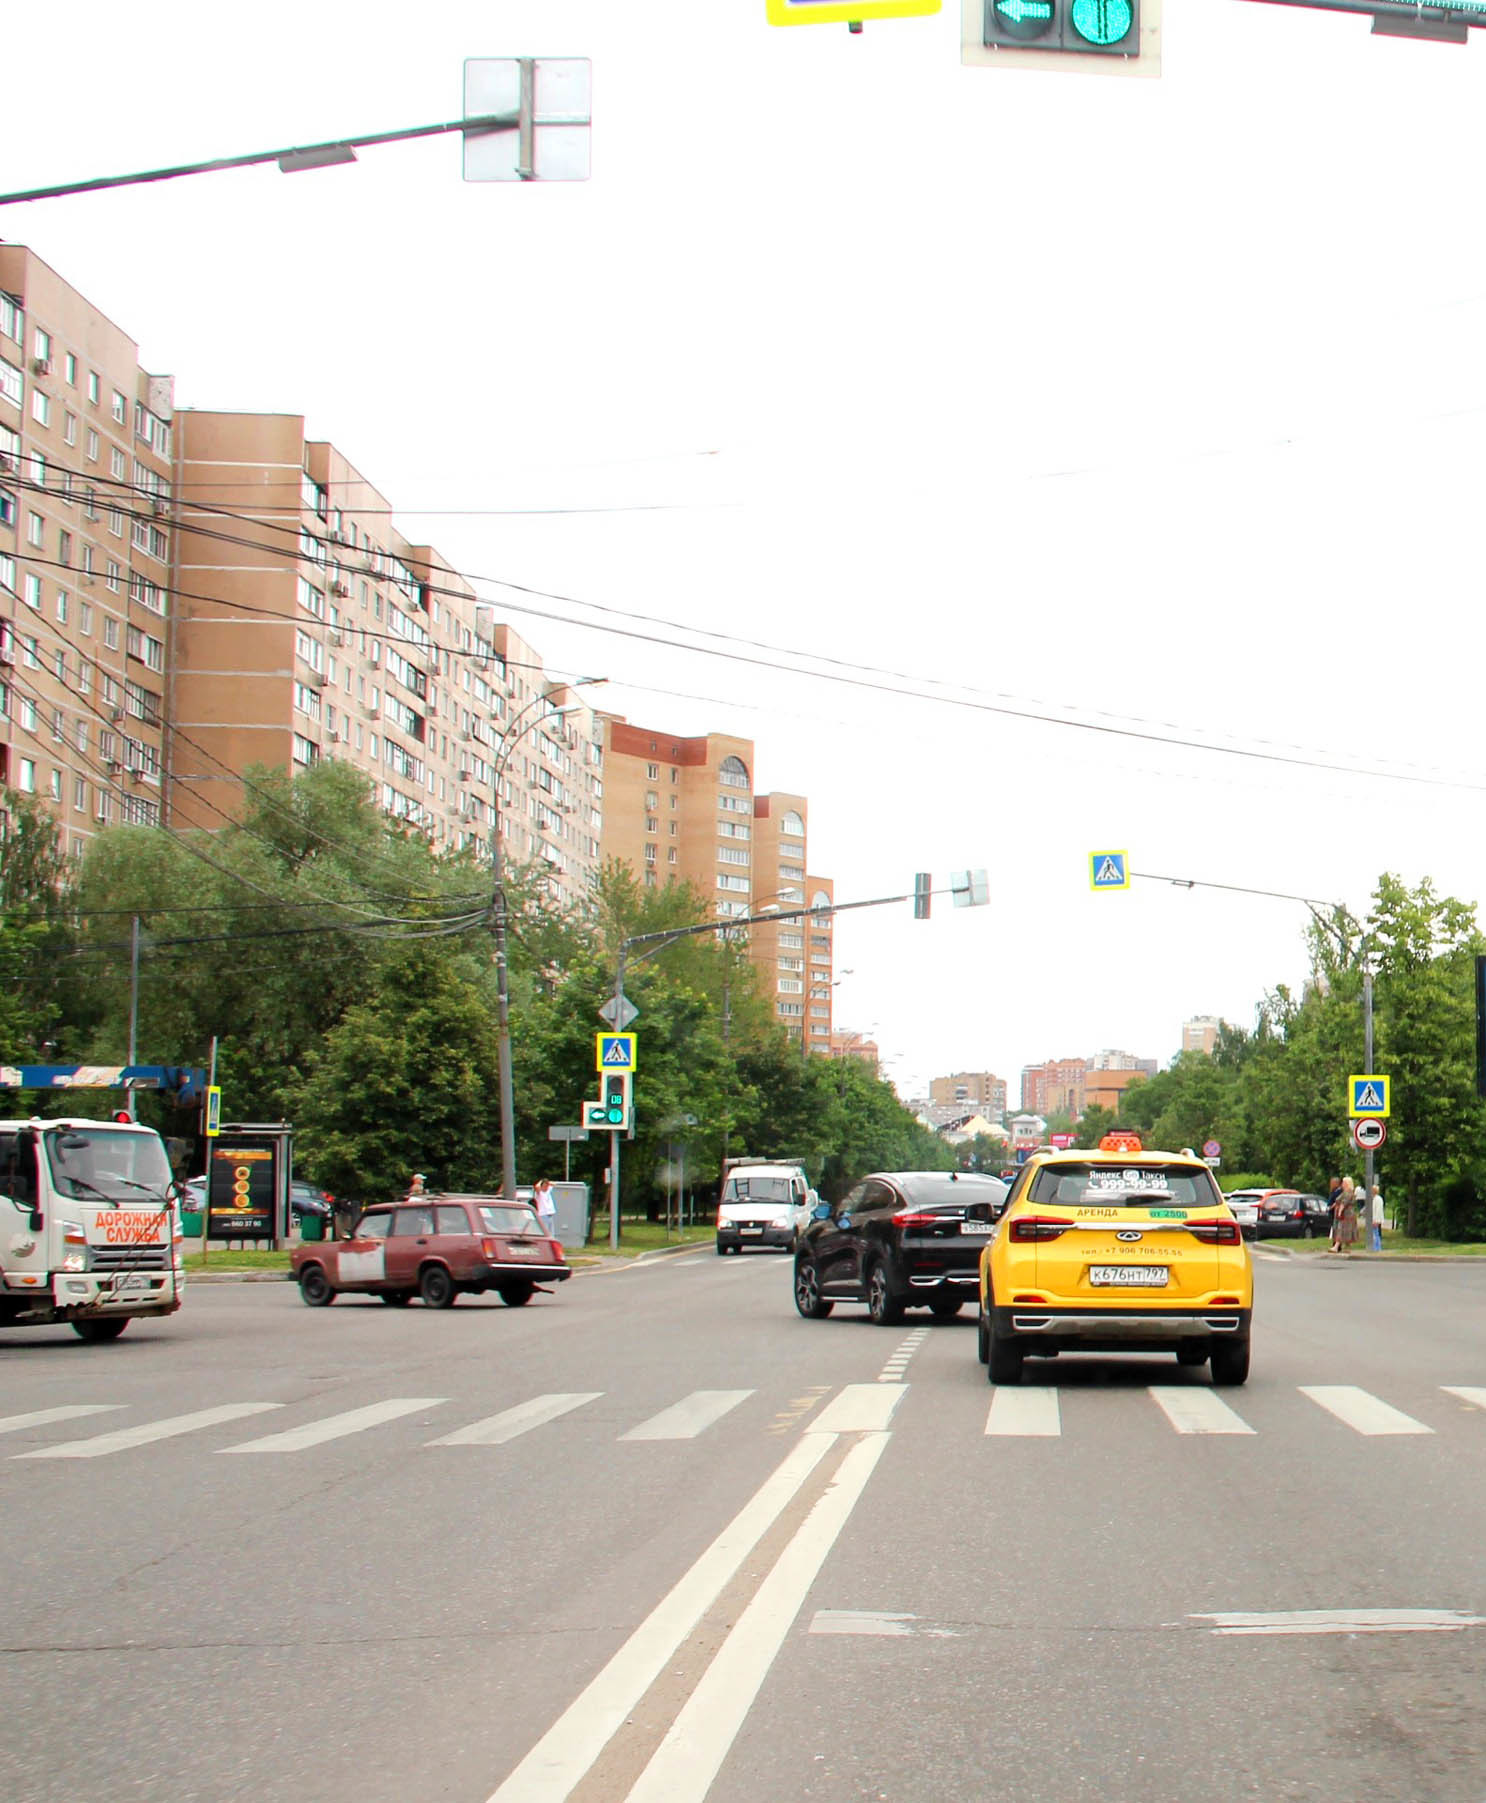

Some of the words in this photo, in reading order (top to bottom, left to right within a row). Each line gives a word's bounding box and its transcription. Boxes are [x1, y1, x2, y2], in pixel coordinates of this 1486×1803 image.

[1089, 1171, 1121, 1180] Яндекс
[1077, 1208, 1118, 1217] АРЕНДА
[96, 1211, 167, 1228] ДОРОЖНАЯ
[106, 1227, 160, 1242] СЛУЖБА
